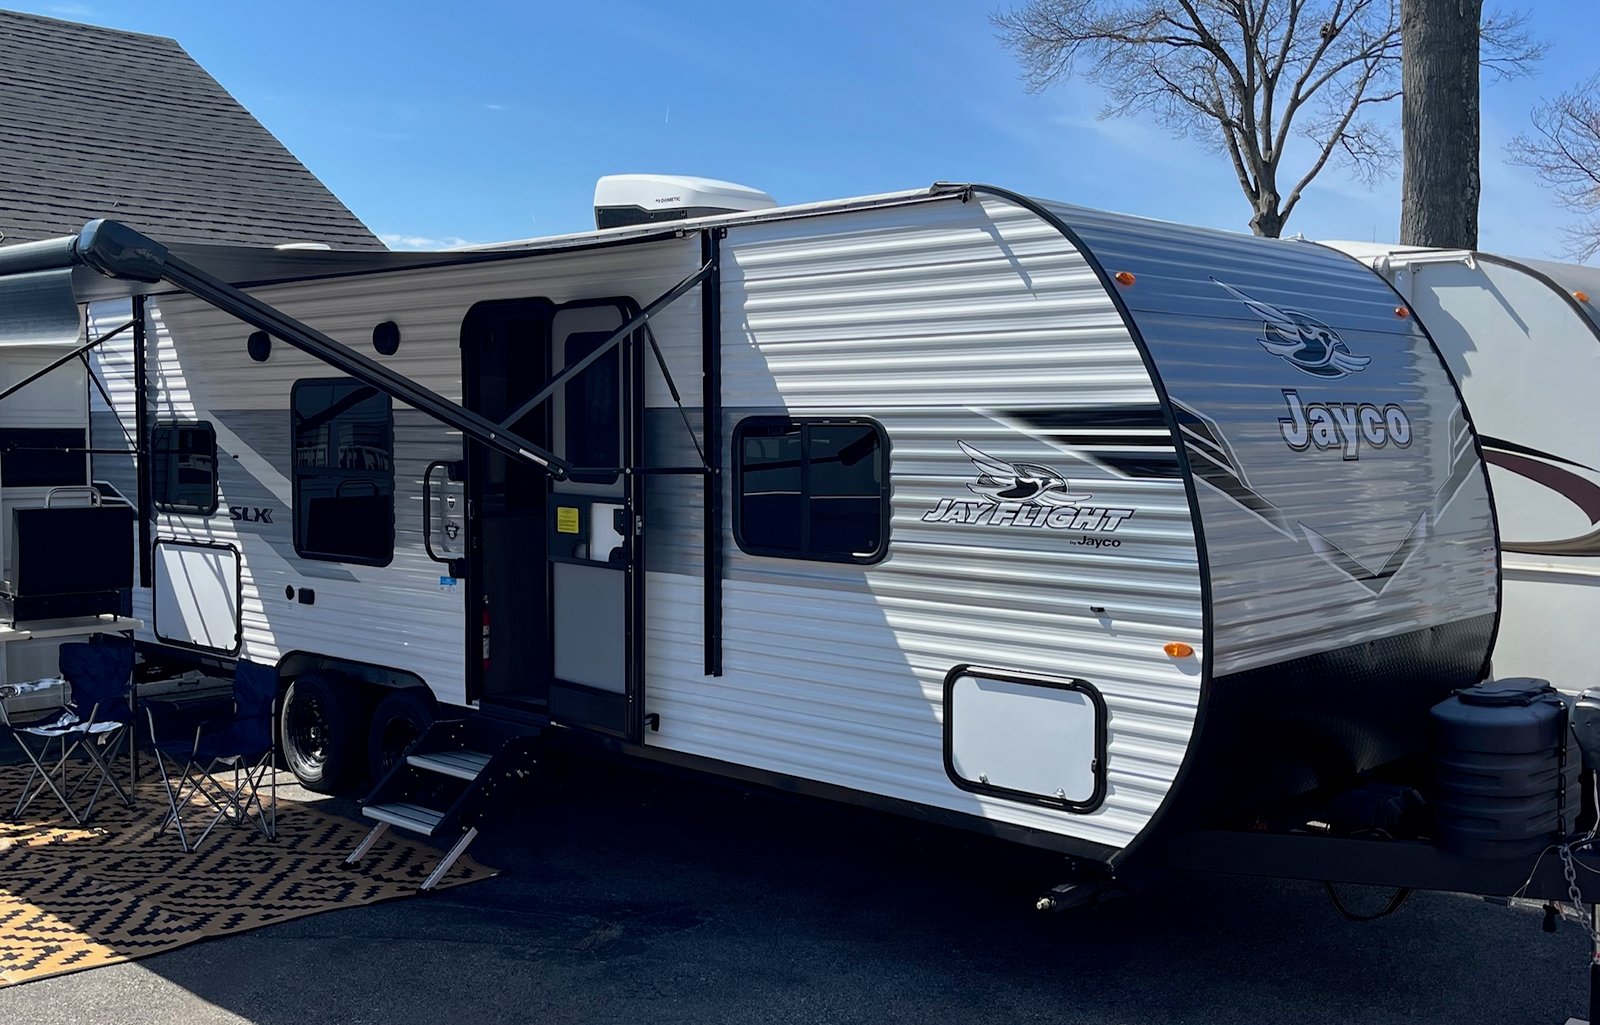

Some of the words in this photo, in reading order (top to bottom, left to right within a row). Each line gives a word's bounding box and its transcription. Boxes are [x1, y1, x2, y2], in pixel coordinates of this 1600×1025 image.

[1277, 388, 1413, 461] Jayco
[229, 506, 273, 524] SLX
[1077, 535, 1121, 549] Jayco
